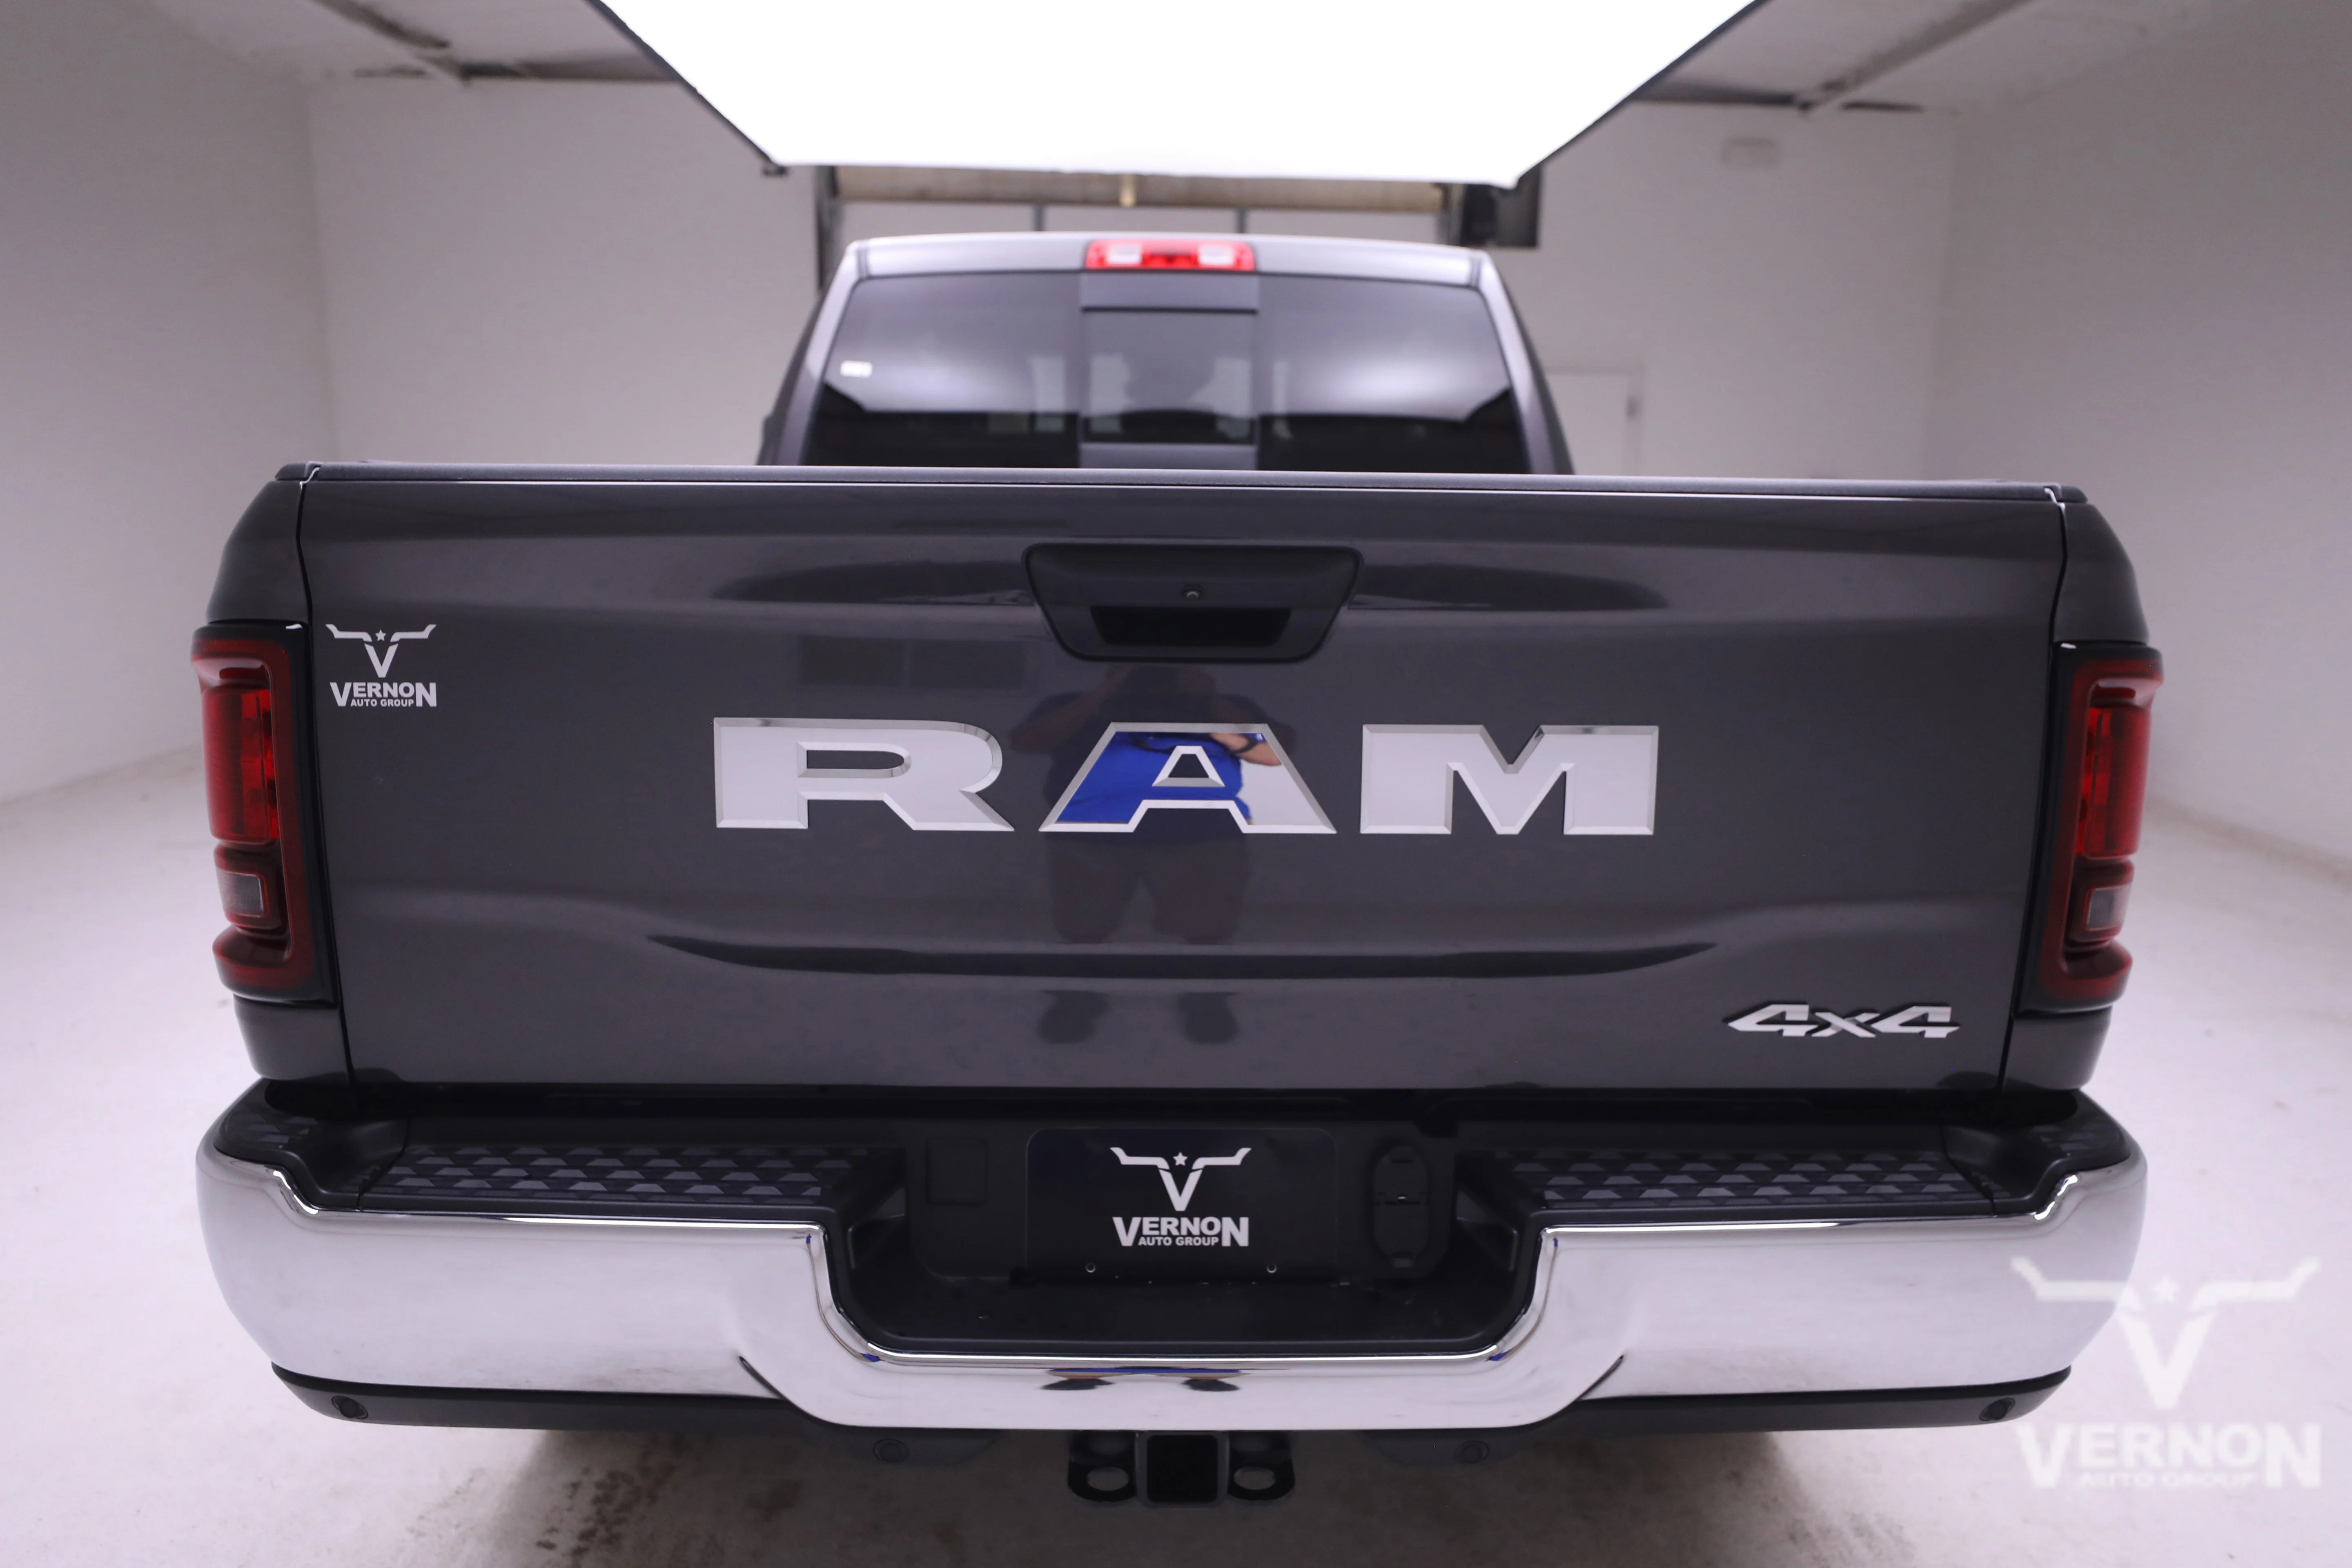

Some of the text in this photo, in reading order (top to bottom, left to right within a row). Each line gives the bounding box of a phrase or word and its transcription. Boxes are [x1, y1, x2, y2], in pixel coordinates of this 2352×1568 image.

[330, 682, 437, 707] VERNON
[714, 717, 1659, 835] RAM
[1112, 1217, 1249, 1246] VERNON
[1138, 1236, 1219, 1246] AUTO GROUP
